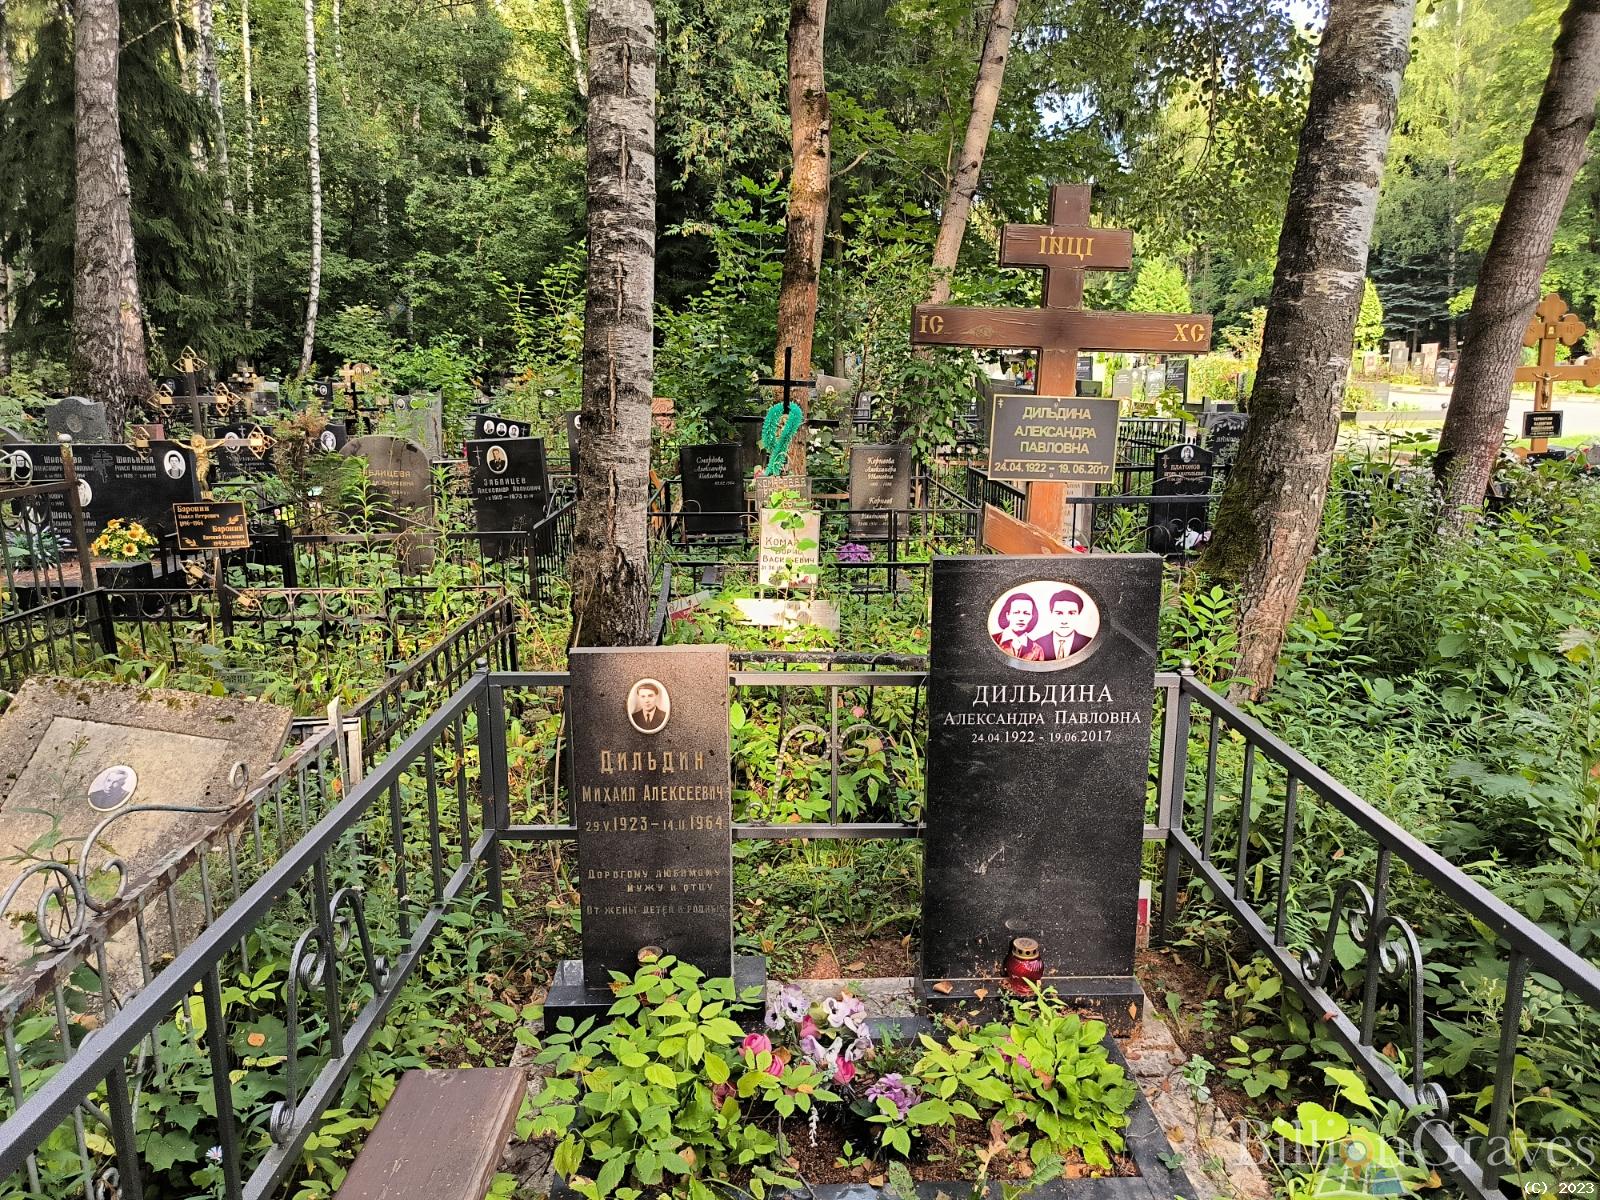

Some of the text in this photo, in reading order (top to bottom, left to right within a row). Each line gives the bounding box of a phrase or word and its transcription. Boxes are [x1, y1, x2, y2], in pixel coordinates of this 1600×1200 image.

[1022, 406, 1092, 420] ДИЛЬДИНА
[1014, 425, 1097, 440] АЛЕКСАНДРА
[1020, 441, 1090, 454] ПАВЛОВНА
[972, 684, 1114, 707] ДИЛЬДИНА
[944, 710, 1141, 727] АЛЕКСАНДРА ПАВЛОВНА
[971, 730, 1035, 743] 24.04.1922
[1050, 730, 1112, 742] 19.06.2017
[600, 750, 705, 774] ДИЛЬДИН
[582, 784, 723, 802] МИХАИЛ АЛЕКСЕЕВИЧ
